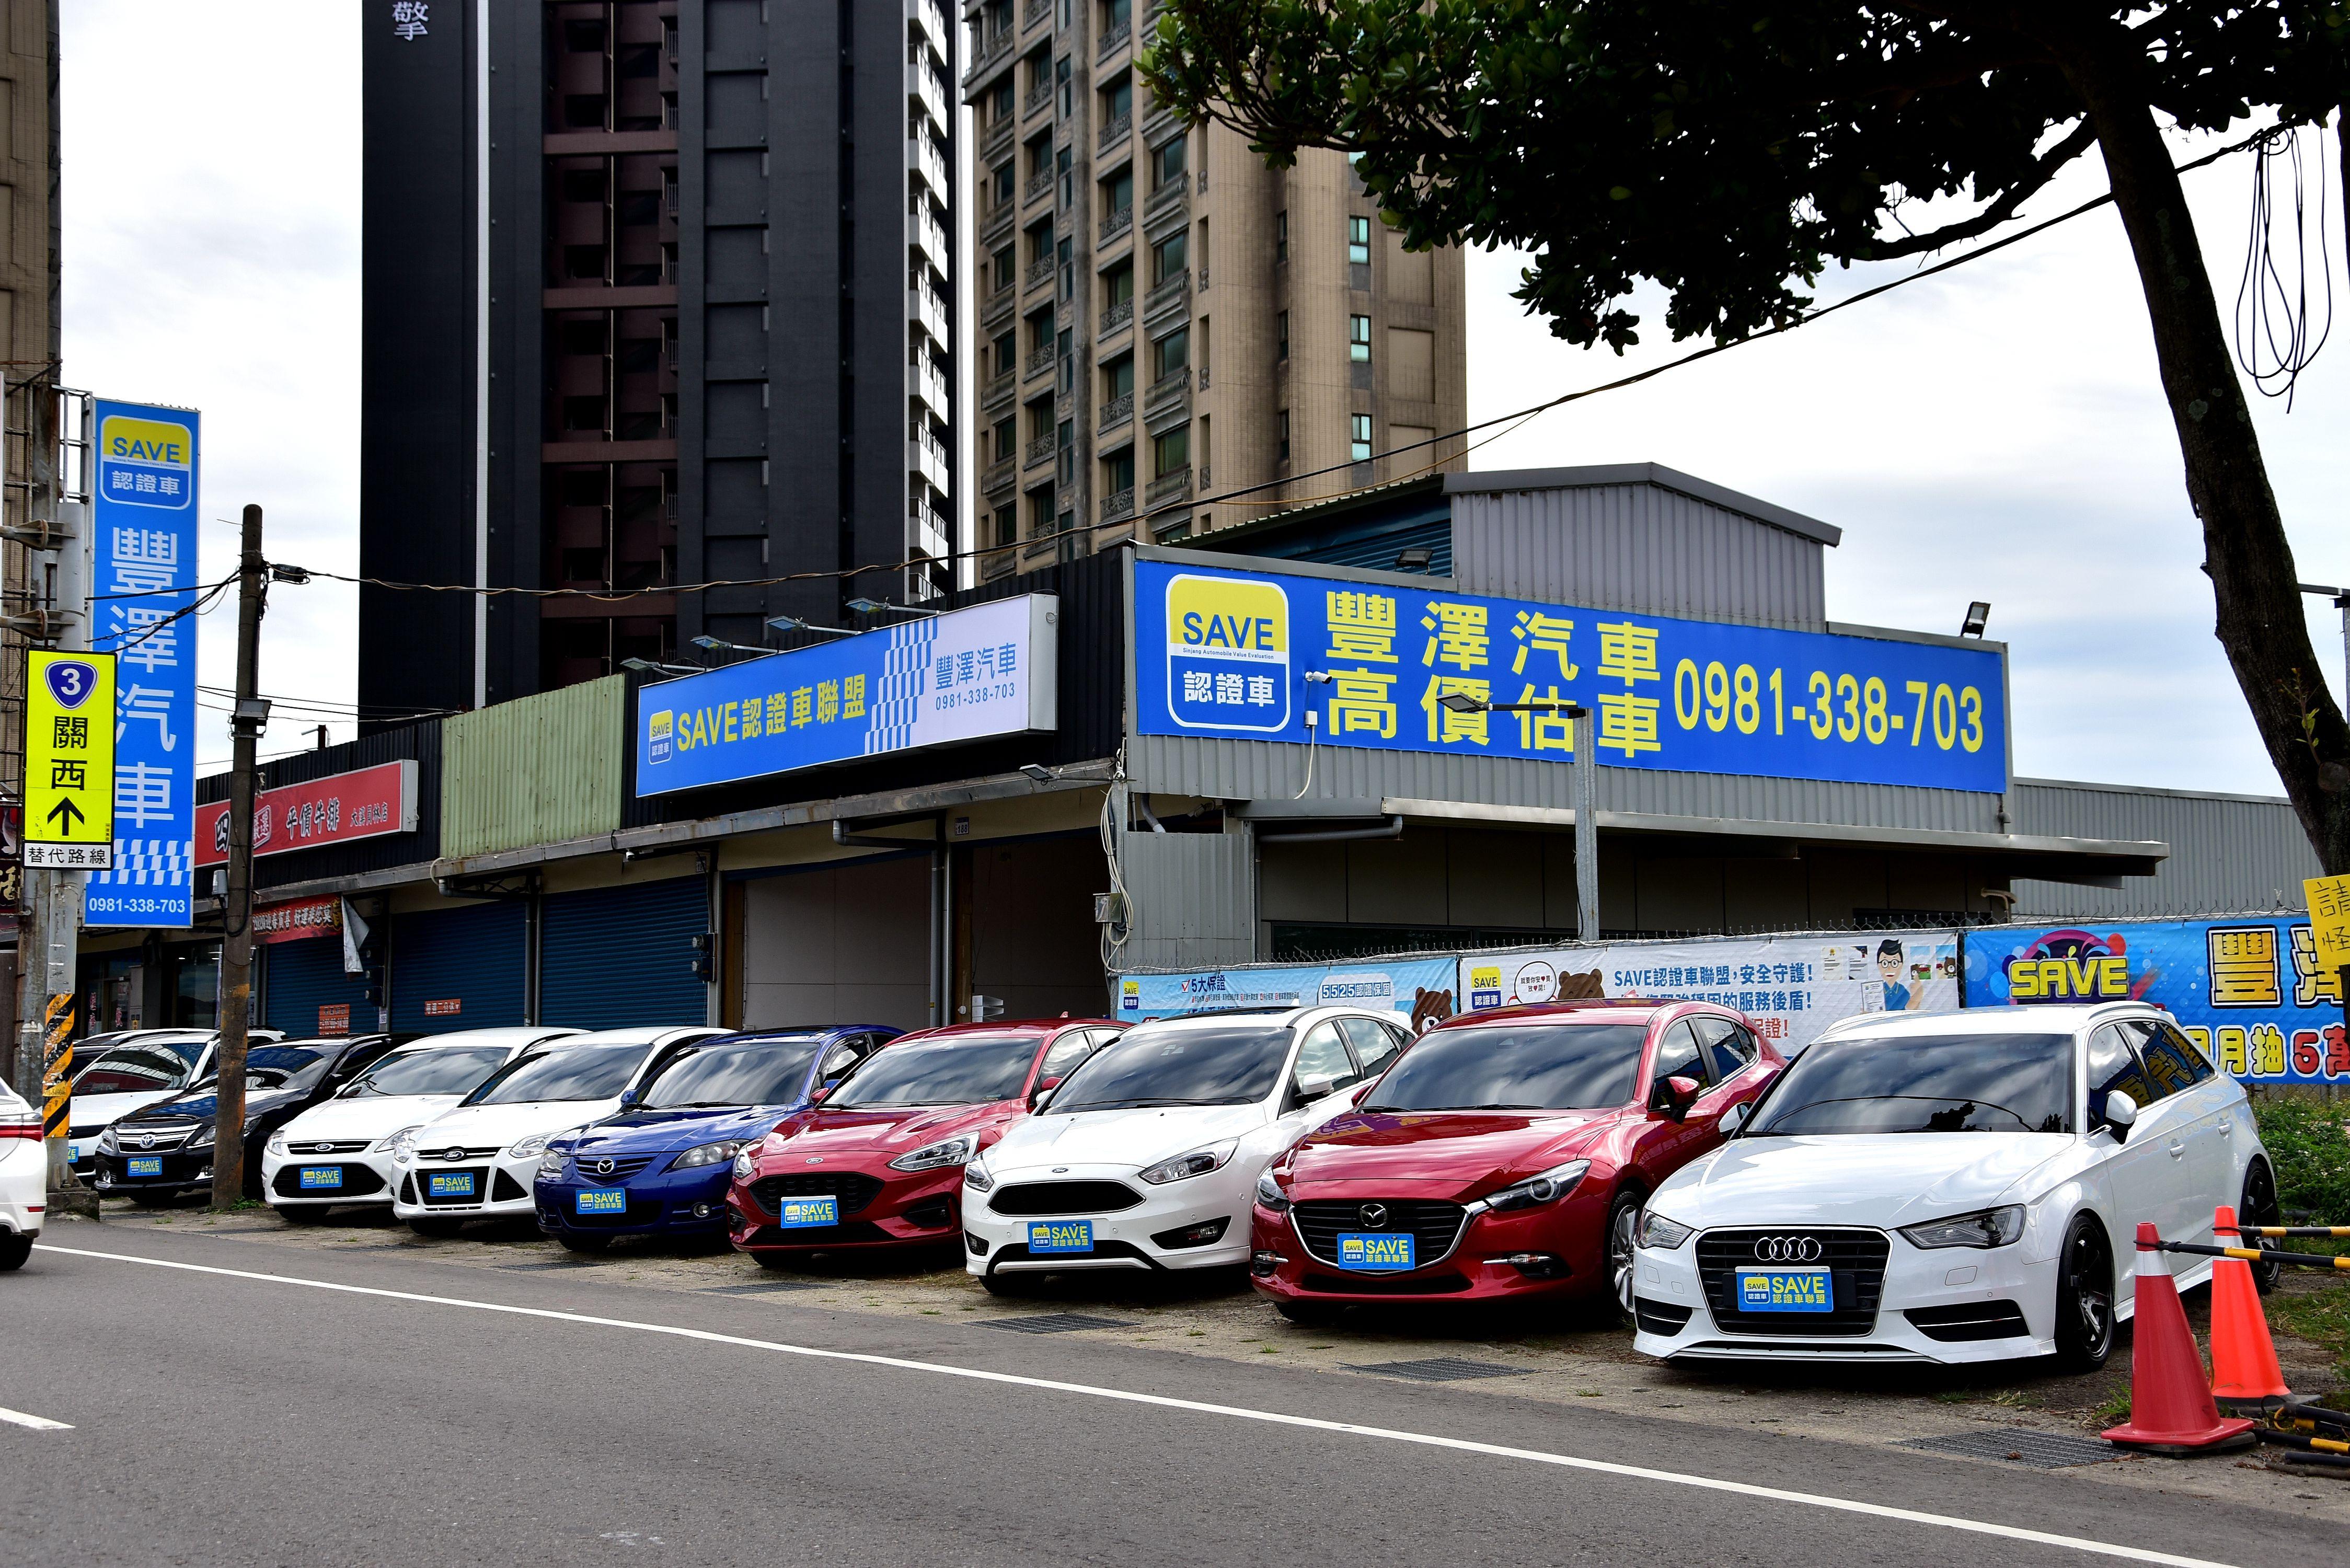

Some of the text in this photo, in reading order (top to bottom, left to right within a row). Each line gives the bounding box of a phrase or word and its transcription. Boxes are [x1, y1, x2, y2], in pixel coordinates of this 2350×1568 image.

[393, 1, 429, 41] 擎
[113, 437, 180, 463] SAVE
[112, 471, 180, 495] 認證車
[1183, 612, 1274, 651] SAVE
[1326, 591, 1660, 687] 豐澤汽車
[936, 643, 1016, 690] 豐澤汽車
[61, 667, 80, 696] 3
[109, 527, 178, 828] 豐澤汽車
[936, 682, 1015, 711] 0981-338-703
[1183, 671, 1275, 707] 認證車
[677, 674, 866, 751] SAVE認證車聯盟
[1326, 667, 1661, 757] 高價估車
[1674, 658, 1984, 753] 0981-338-703
[652, 722, 670, 737] SAVE
[51, 716, 88, 791] 關西
[286, 797, 340, 840] 平價牛排
[958, 824, 967, 833] 188
[28, 847, 106, 864] 替代路線
[89, 897, 186, 914] 0981-338-703
[1191, 974, 1226, 993] 5大保證
[1474, 976, 1497, 988] SAVE
[2010, 958, 2129, 998] SAVE
[1322, 983, 1390, 998] 5525認證保固
[1474, 995, 1498, 1006] 認證車
[140, 1160, 159, 1168] SAVE
[316, 1170, 339, 1179] SAVE
[446, 1177, 470, 1186] SAVE
[594, 1192, 621, 1203] SAVE
[801, 1203, 833, 1216] SAVE
[1052, 1226, 1088, 1239] SAVE
[1366, 1240, 1409, 1254] SAVE
[1366, 1254, 1409, 1263] 認證車聯盟
[1772, 1276, 1825, 1294] SAVE
[1772, 1294, 1826, 1304] 認證車聯盟
